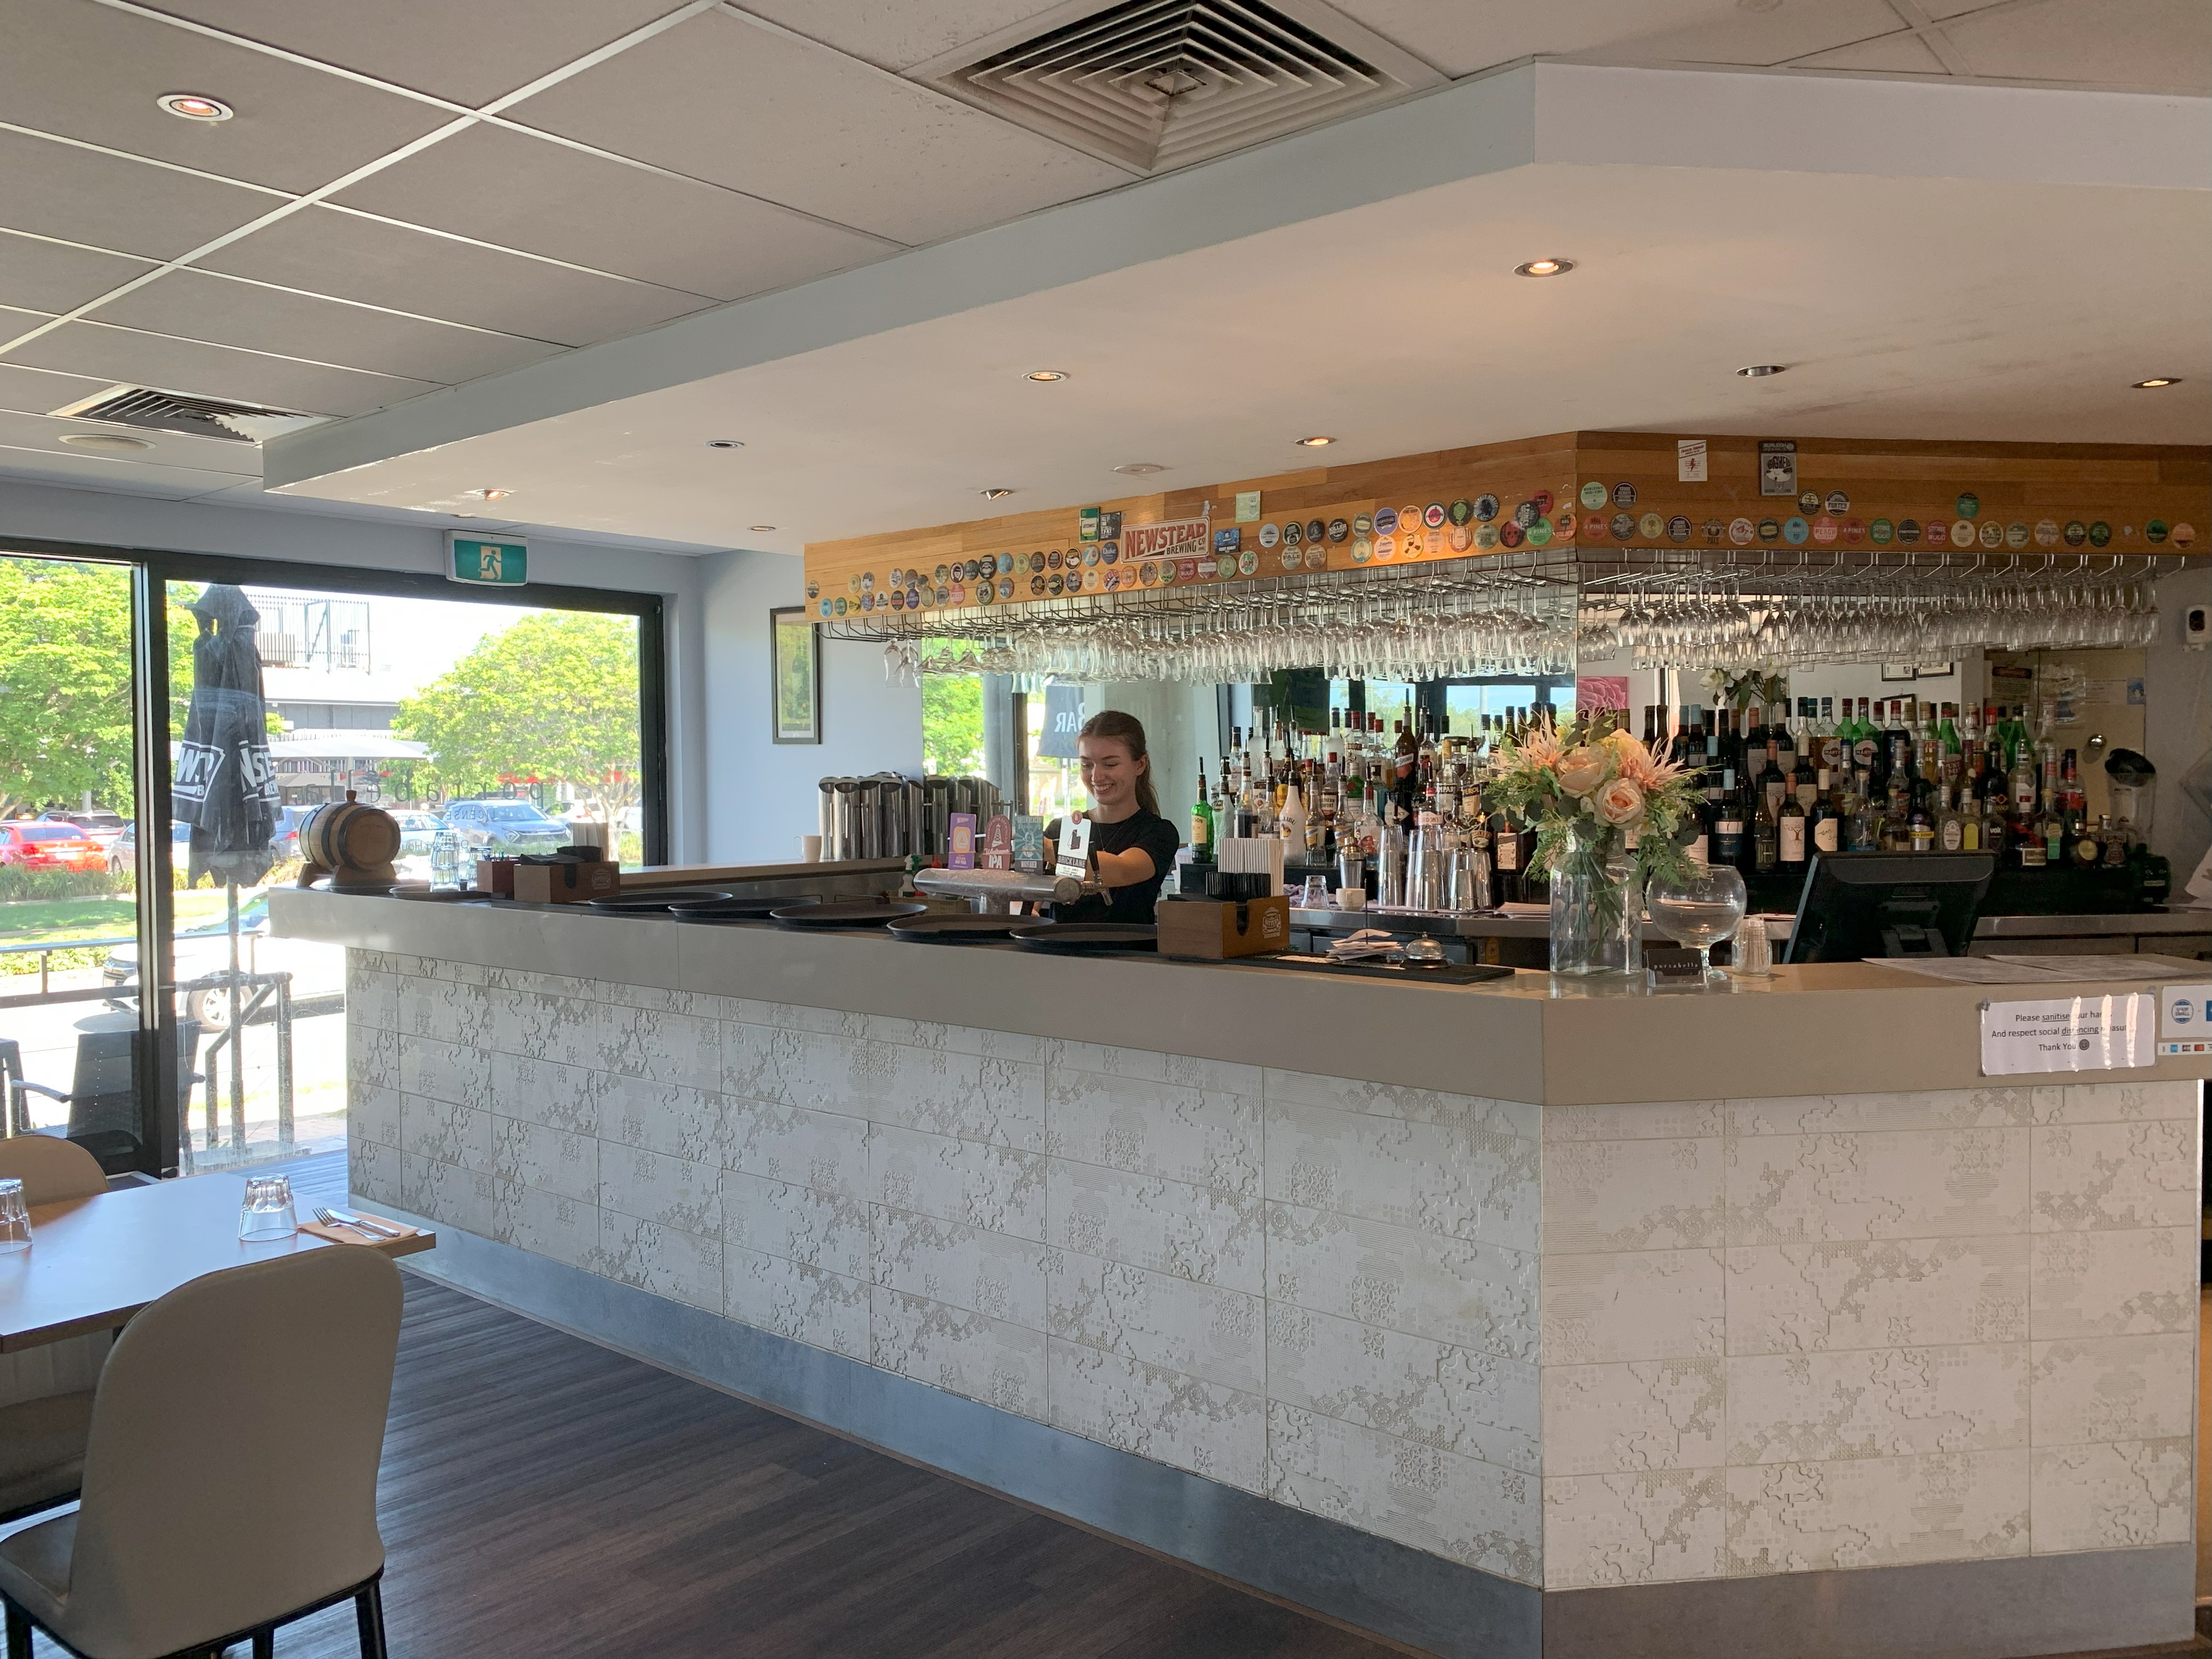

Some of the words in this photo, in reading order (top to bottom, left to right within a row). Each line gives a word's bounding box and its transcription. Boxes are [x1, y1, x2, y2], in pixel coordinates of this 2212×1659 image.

[1329, 523, 1347, 532] KILLER
[1125, 522, 1206, 560] NEWSTEAD
[1166, 540, 1197, 555] BREWING
[988, 854, 1002, 869] IPA
[1654, 962, 1698, 970] portabella
[2016, 1013, 2040, 1022] Please
[2042, 1013, 2070, 1021] sanitise
[1991, 1029, 2006, 1037] And
[2008, 1028, 2037, 1039] respect
[2039, 1026, 2059, 1035] social
[2061, 1025, 2099, 1036] disncing
[2039, 1043, 2061, 1052] Thank
